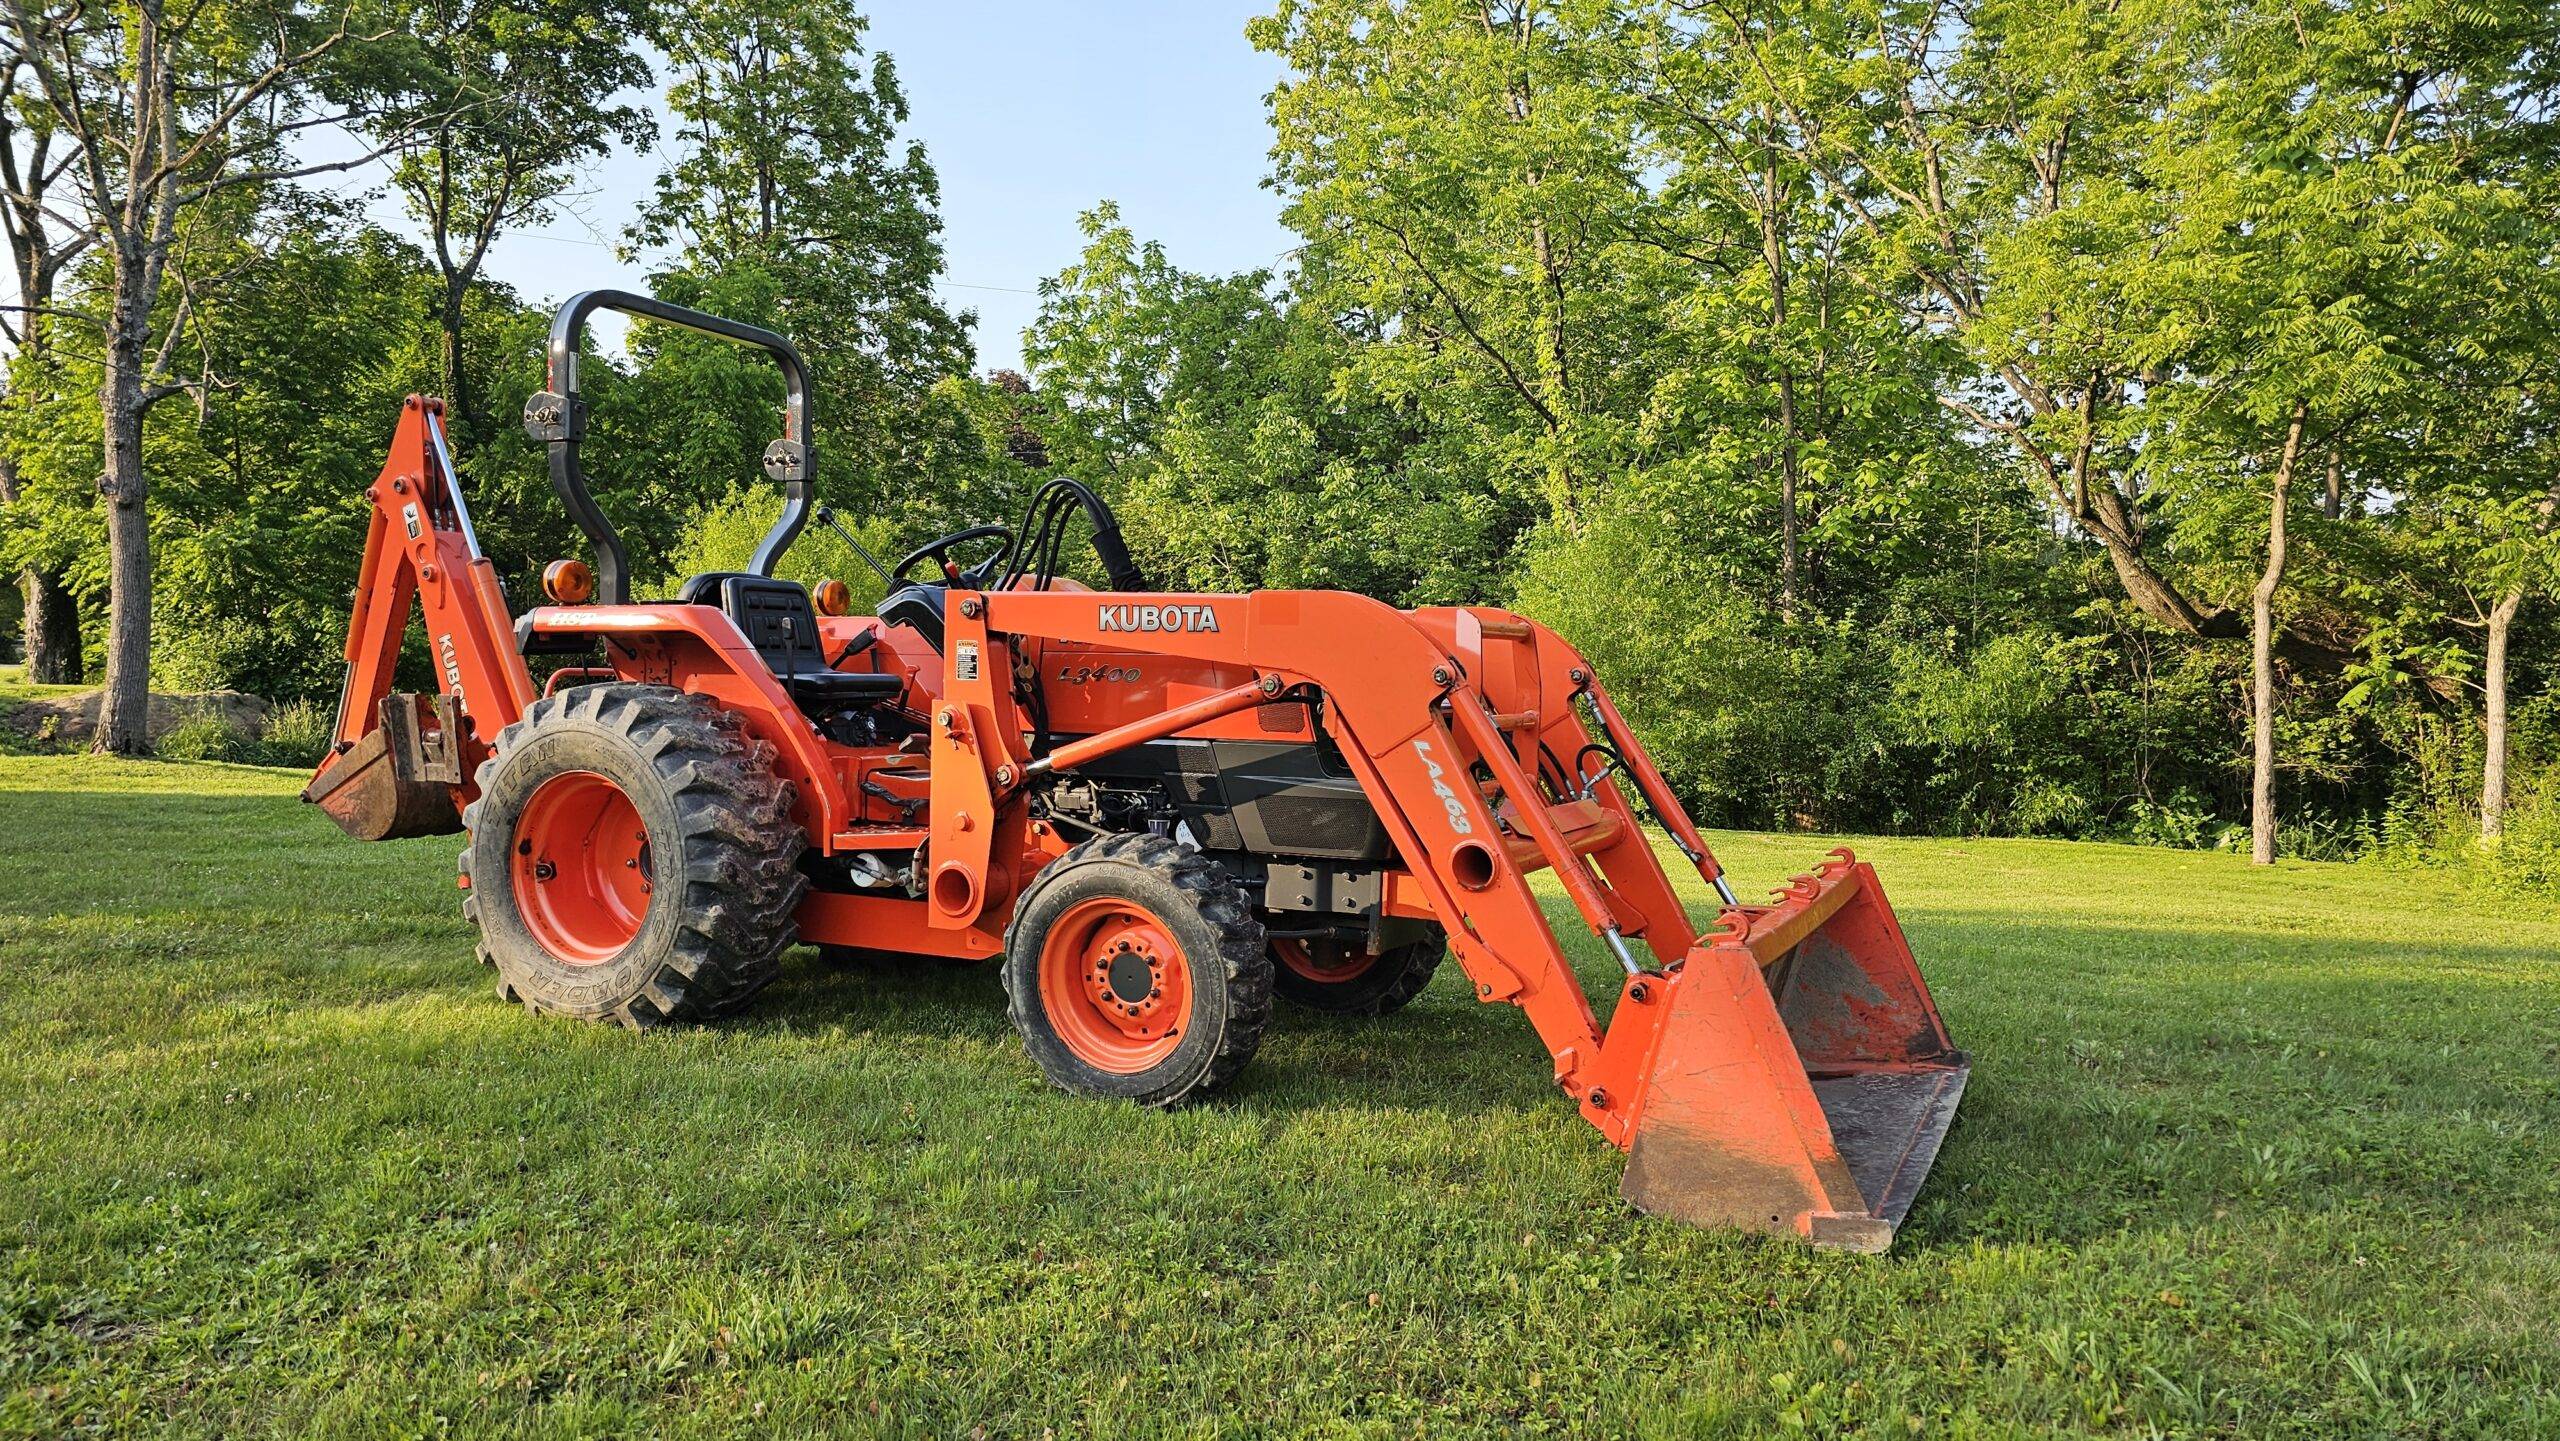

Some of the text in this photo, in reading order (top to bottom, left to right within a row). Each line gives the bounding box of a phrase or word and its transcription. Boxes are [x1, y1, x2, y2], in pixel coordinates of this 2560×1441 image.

[1098, 604, 1219, 633] KUBOTA
[438, 633, 478, 739] KUBOT
[1057, 663, 1142, 686] L3400
[484, 737, 557, 829] TITAN
[1413, 741, 1472, 834] LA463
[528, 946, 647, 1000] LOADER
